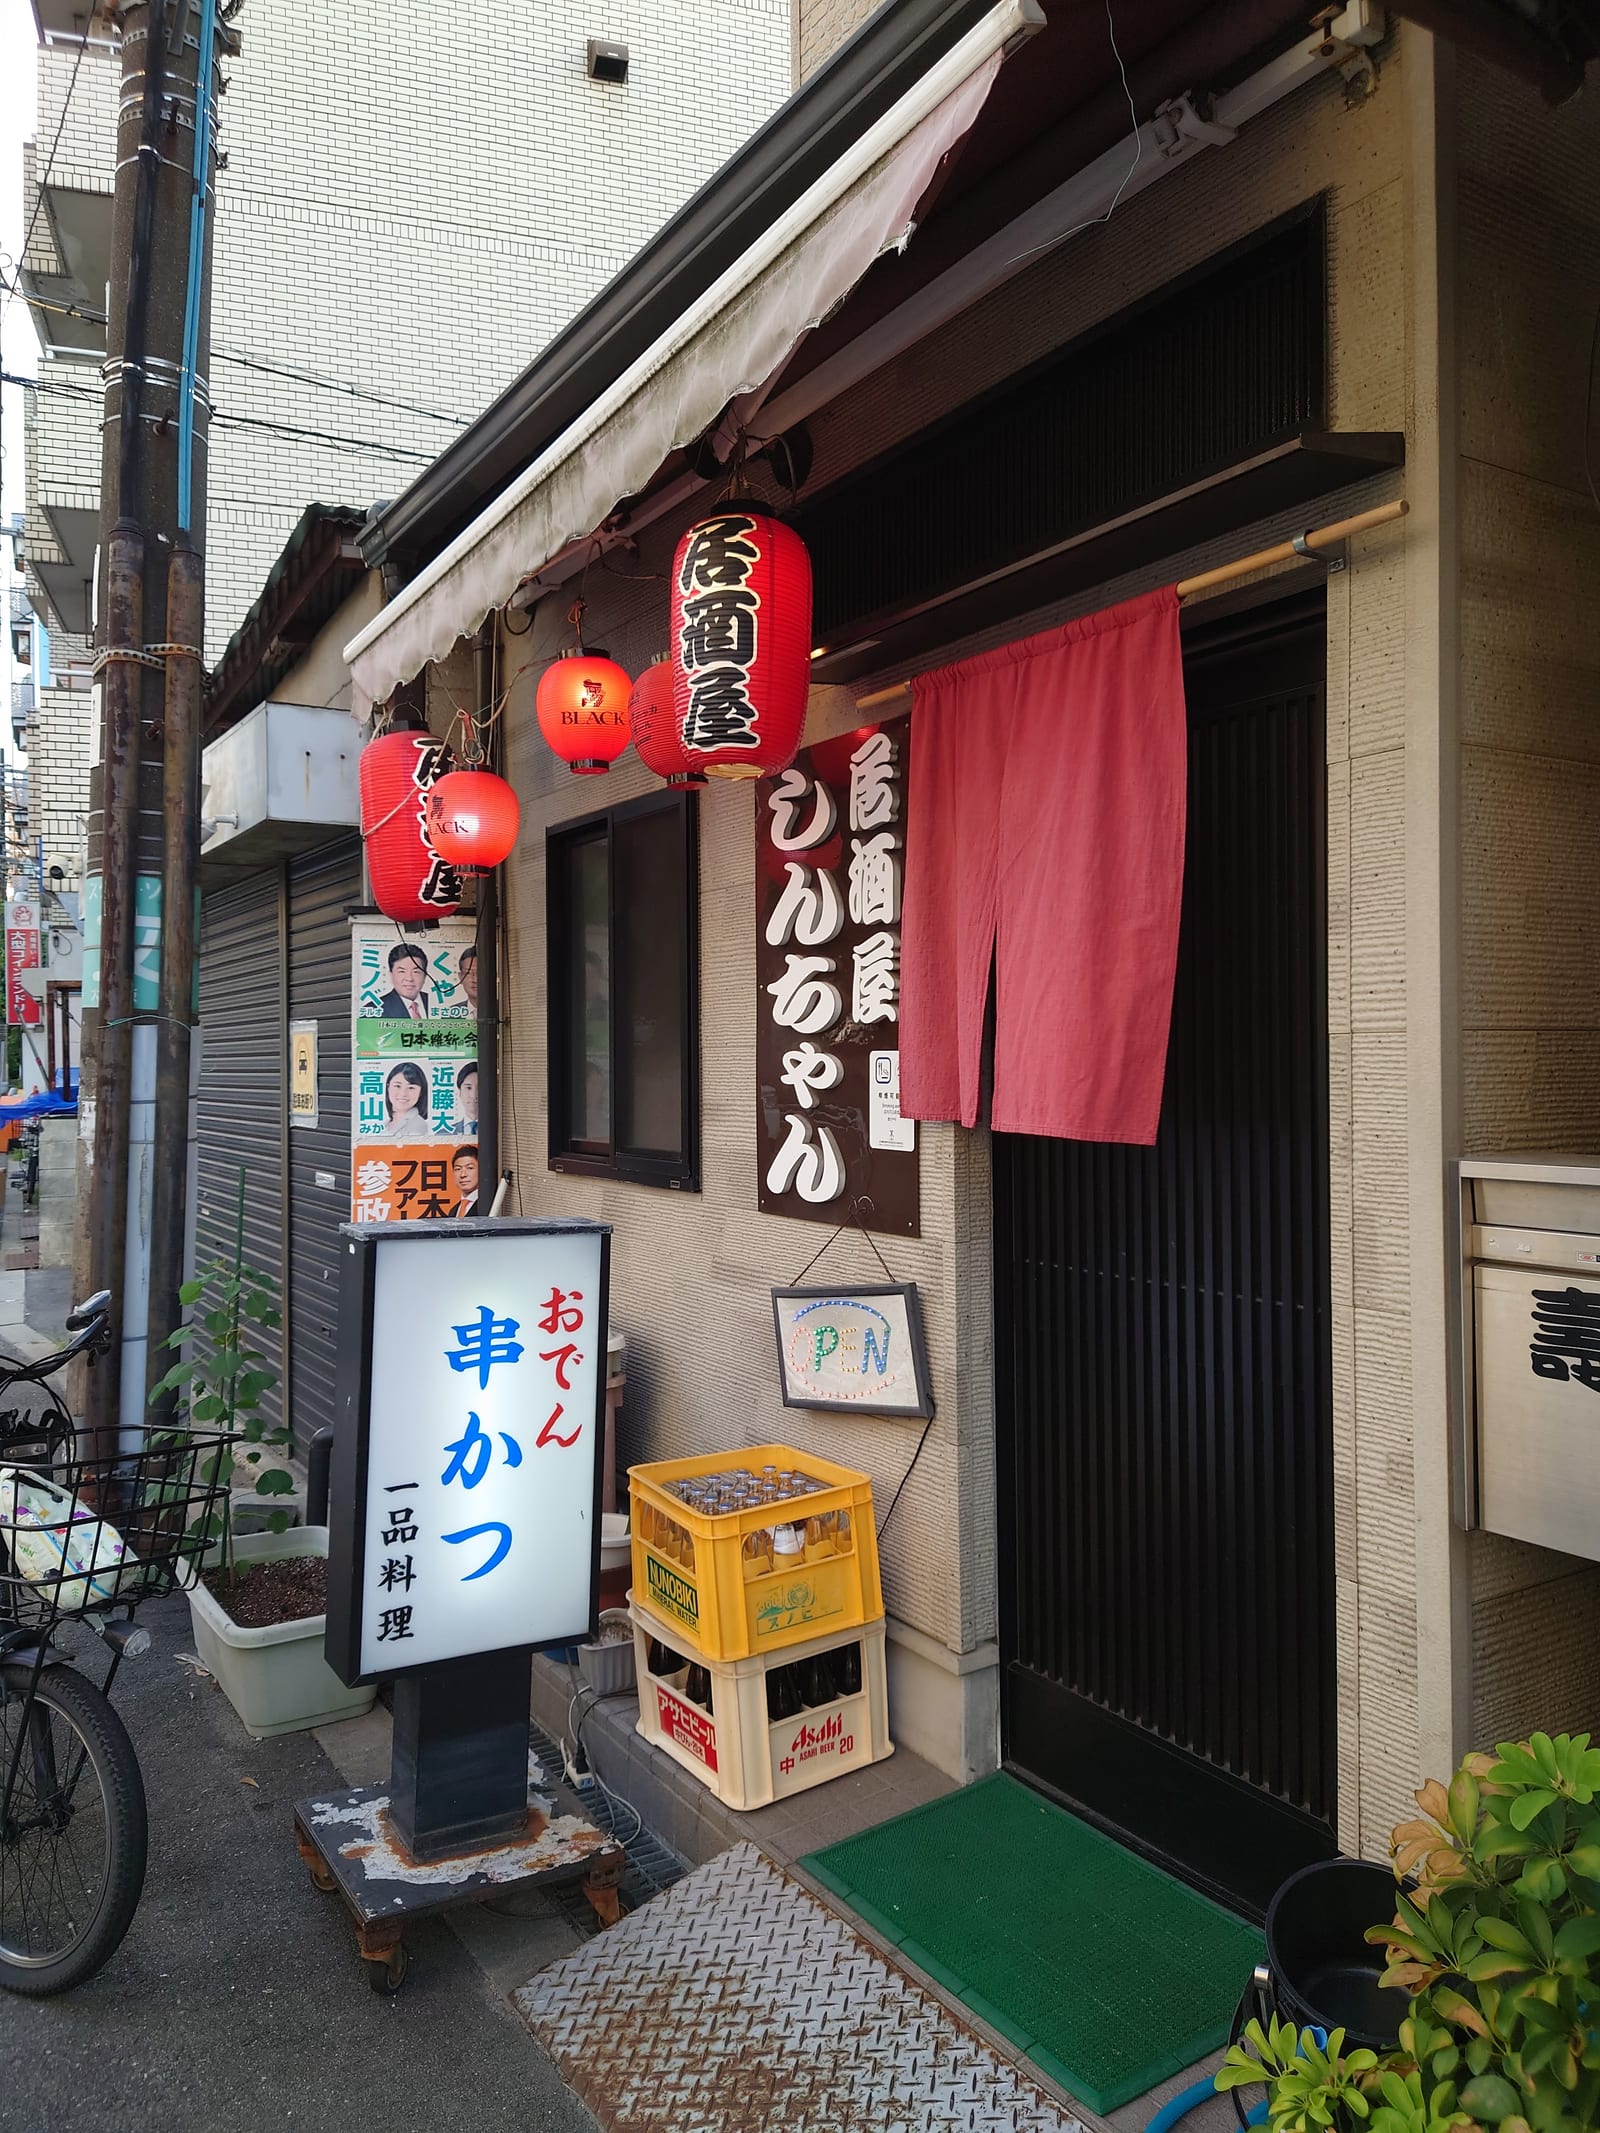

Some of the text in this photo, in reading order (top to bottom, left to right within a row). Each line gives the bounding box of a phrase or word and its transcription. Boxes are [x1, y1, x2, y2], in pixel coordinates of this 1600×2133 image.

[679, 515, 761, 751] 居酒屋
[561, 711, 625, 725] BLACK
[849, 732, 899, 1024] 居酒屋
[360, 949, 384, 1006] ミノベ
[431, 951, 455, 1004] くや
[359, 1007, 384, 1017] テルオ
[431, 1007, 469, 1017] まさのり
[401, 1030, 478, 1050] 日本維新の会
[359, 1071, 385, 1121] 高山
[432, 1066, 455, 1134] 近藤大
[359, 1123, 385, 1134] みか
[418, 1160, 451, 1220] 日本
[535, 1286, 584, 1450] おでん
[789, 1325, 892, 1376] OPEN
[440, 1305, 525, 1582] 串かつ
[377, 1480, 419, 1642] 一品料理
[649, 1560, 697, 1615] NUNOBIKI
[652, 1586, 697, 1628] MINERAL WATER
[658, 1690, 717, 1750] アサヒビール
[792, 1712, 842, 1752] Asahi
[839, 1735, 854, 1755] 20
[780, 1756, 795, 1775] 中
[799, 1742, 835, 1762] ASAHI BEER
